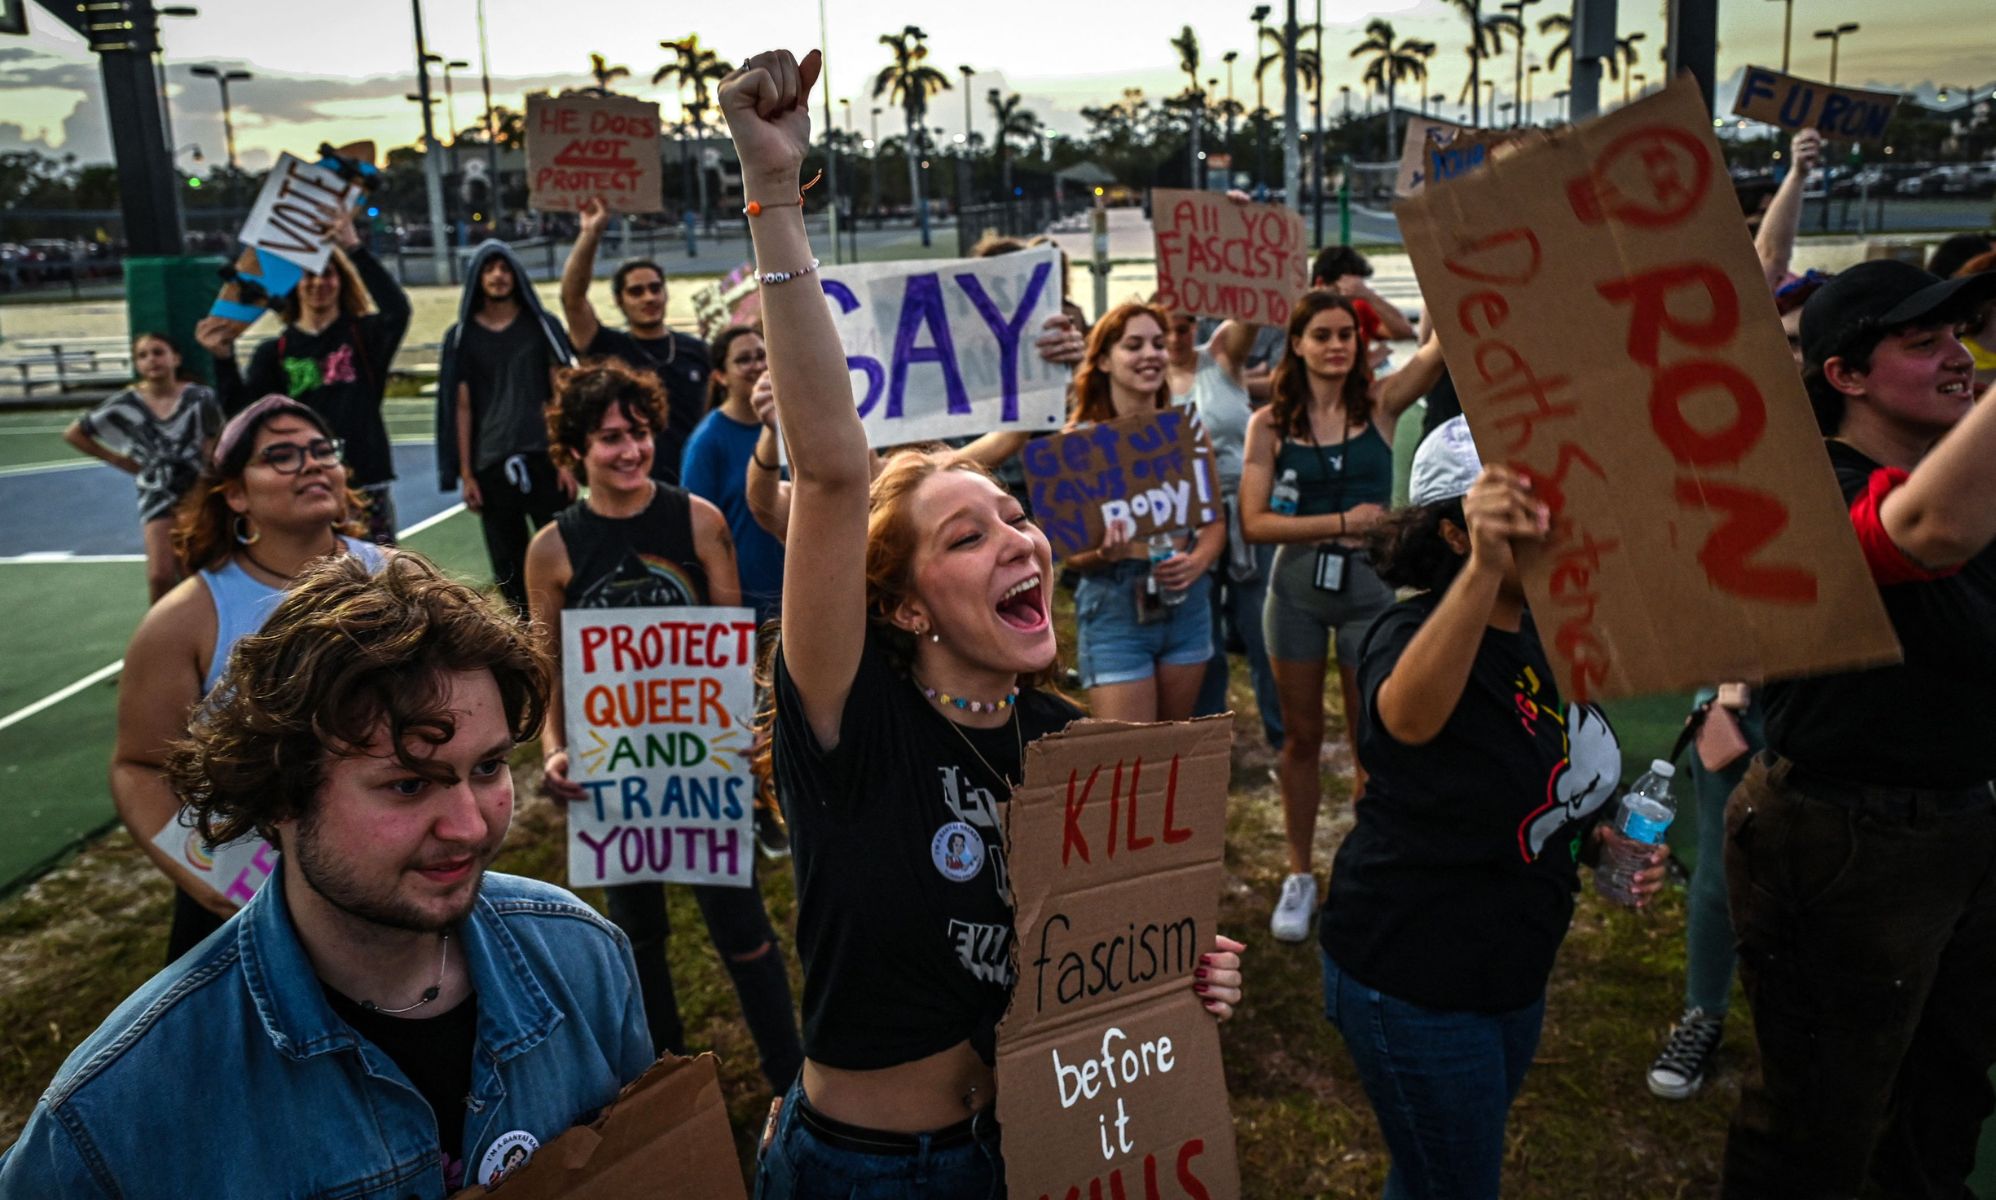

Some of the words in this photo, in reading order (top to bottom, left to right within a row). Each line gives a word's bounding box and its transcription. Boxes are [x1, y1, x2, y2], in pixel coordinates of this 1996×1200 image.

[538, 108, 580, 135] HE
[590, 110, 656, 139] DOES
[1742, 71, 1776, 108] F
[1779, 84, 1812, 127] U
[1818, 93, 1890, 137] RON
[557, 138, 631, 162] NOT
[535, 167, 644, 192] PROTECT
[257, 160, 349, 255] VOTE
[1157, 271, 1259, 320] BOUND
[1263, 288, 1290, 326] TO
[1594, 262, 1818, 605] RON
[1506, 440, 1621, 706] Stence
[579, 621, 756, 674] PROTECT
[583, 677, 731, 729] QUEER
[606, 731, 708, 772] AND
[580, 775, 744, 822] TRANS
[1062, 753, 1193, 867] KILL
[576, 825, 740, 880] YOUTH
[1033, 913, 1197, 1013] fascism
[1052, 1028, 1175, 1108] before
[1099, 1098, 1135, 1160] it
